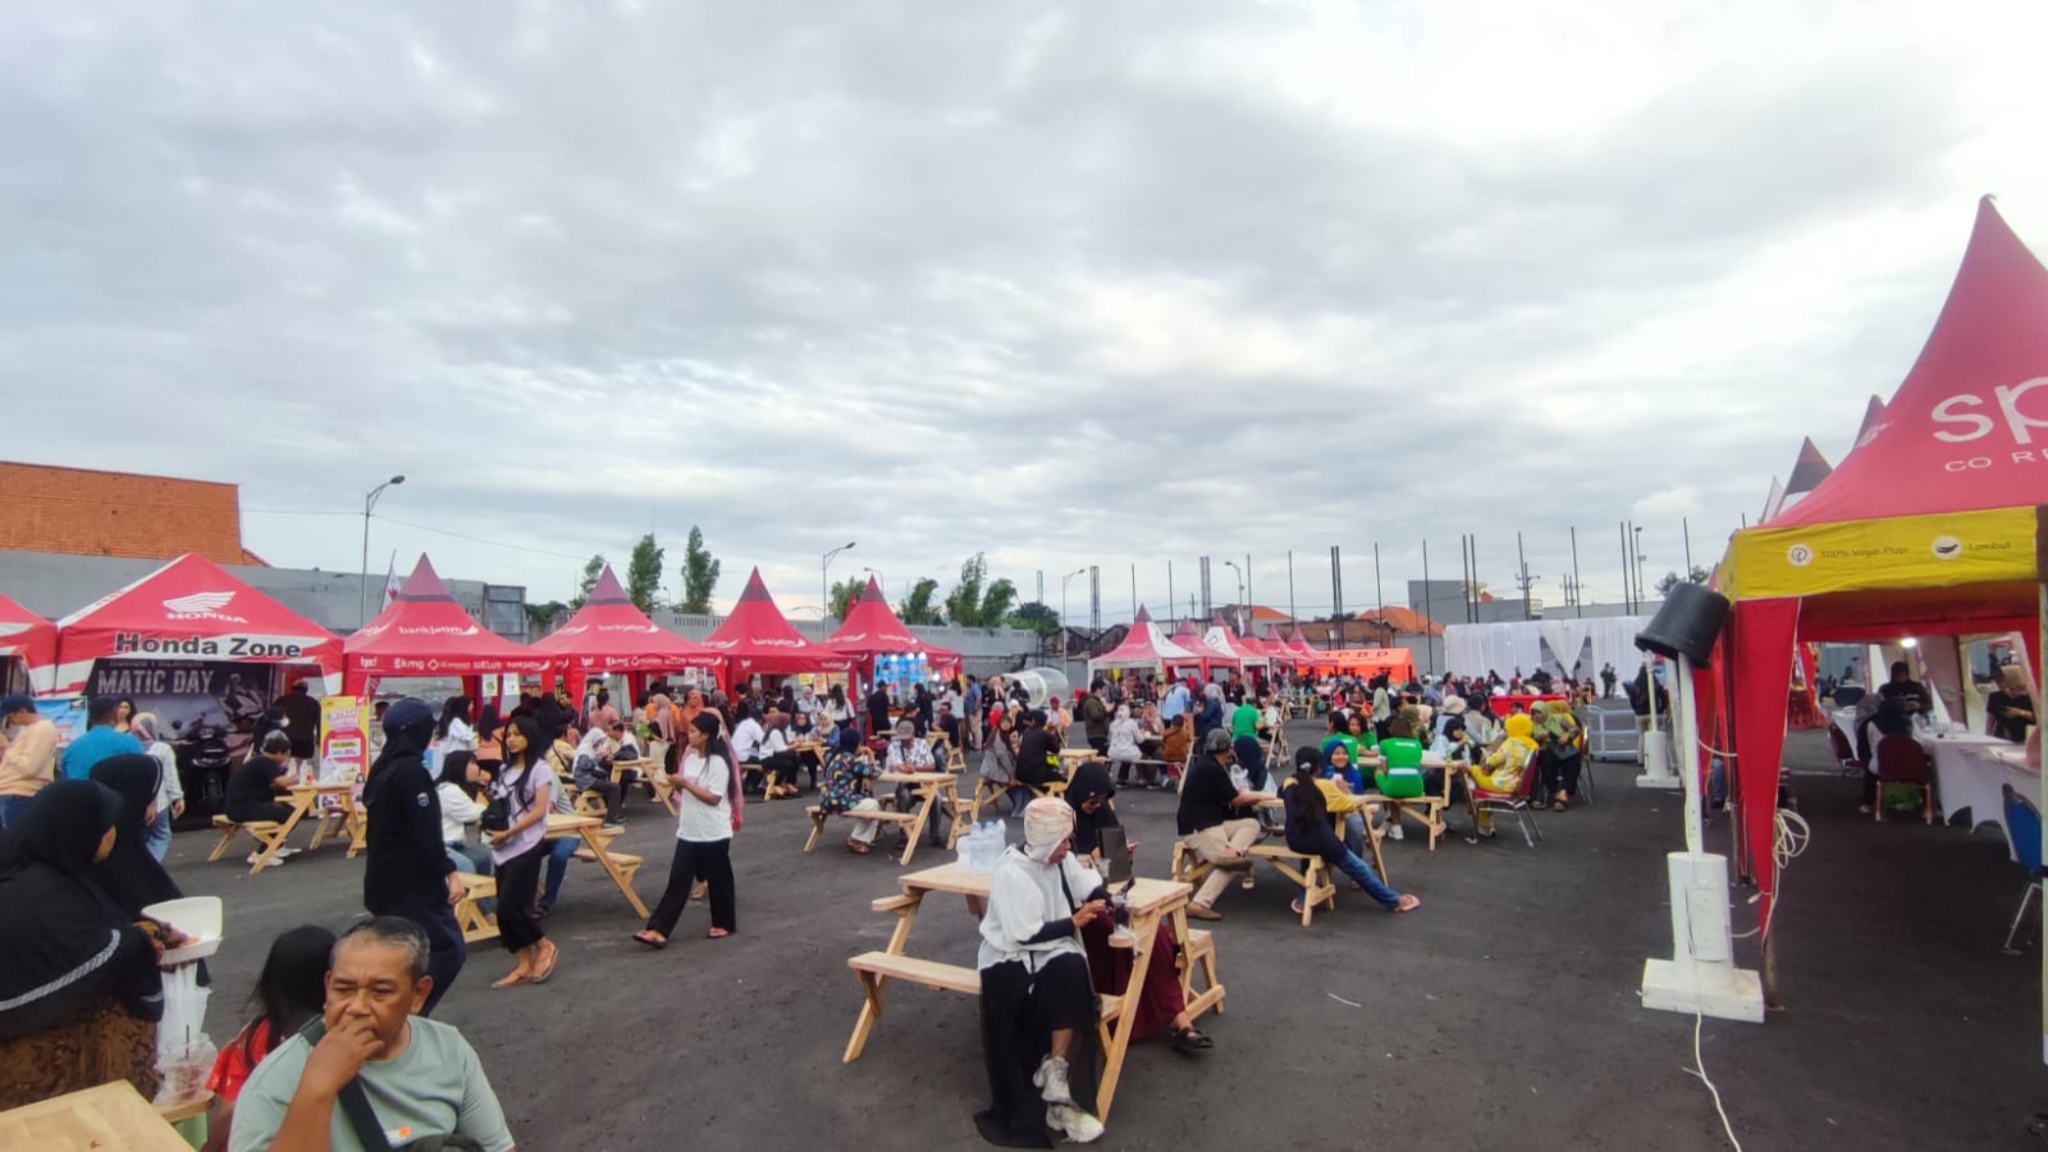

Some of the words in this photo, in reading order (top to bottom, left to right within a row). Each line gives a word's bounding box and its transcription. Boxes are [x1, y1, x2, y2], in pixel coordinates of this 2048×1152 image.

[165, 612, 248, 624] HONDA
[115, 632, 218, 655] Honda
[229, 637, 302, 658] Zone
[97, 669, 167, 695] MATIC
[173, 669, 214, 695] DAY
